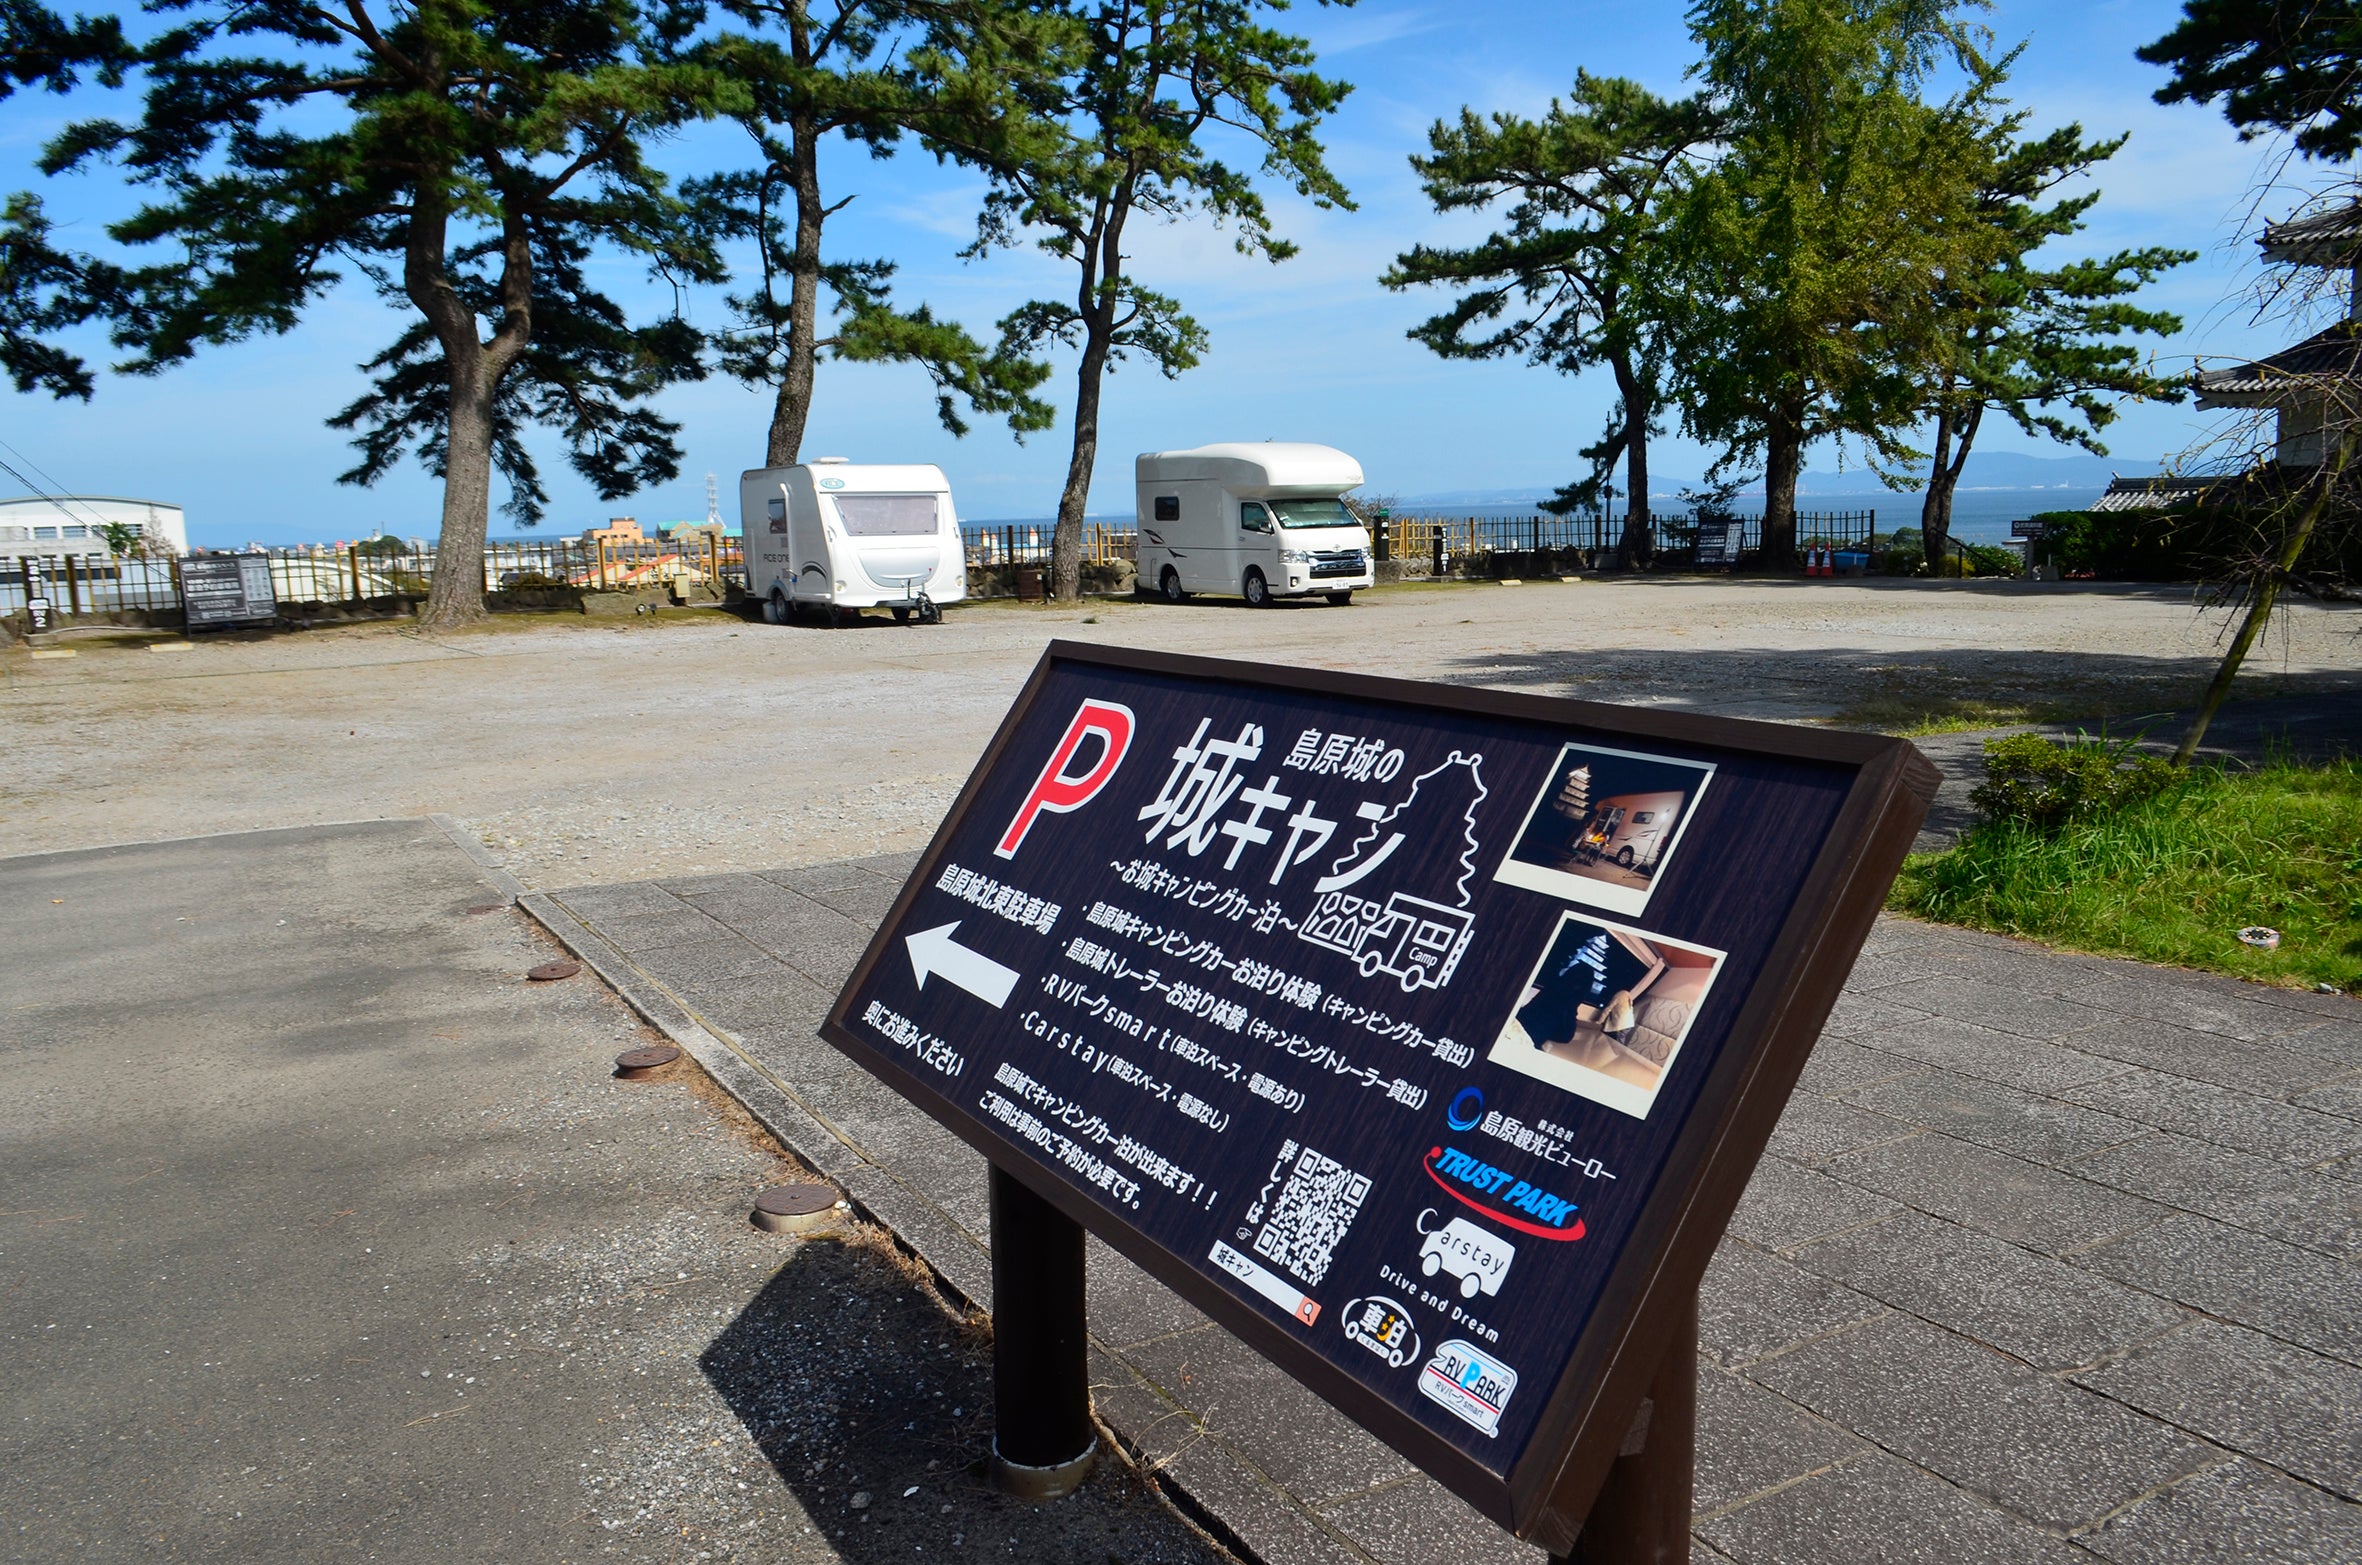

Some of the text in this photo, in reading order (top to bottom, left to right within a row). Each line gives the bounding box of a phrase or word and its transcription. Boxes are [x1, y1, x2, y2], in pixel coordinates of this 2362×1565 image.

[993, 697, 1136, 861] P
[1282, 728, 1405, 783] 島原城の
[1137, 717, 1406, 893] 城キャン
[935, 863, 1062, 935] 島原城北東駐車場
[1409, 947, 1438, 968] Camp
[861, 1000, 965, 1077] 奥にお進みください
[978, 1090, 1141, 1210] ご利用は事前のご予約が必要です。
[1480, 1110, 1617, 1179] 島原観光ビューロー
[1537, 1119, 1575, 1143] 株式会社
[1245, 1138, 1299, 1225] 詳しくは
[1435, 1147, 1578, 1227] TRUST PARK
[1216, 1247, 1254, 1277] 城キャン
[1416, 1208, 1505, 1275] Carstay
[1379, 1264, 1500, 1344] Drive and Dream
